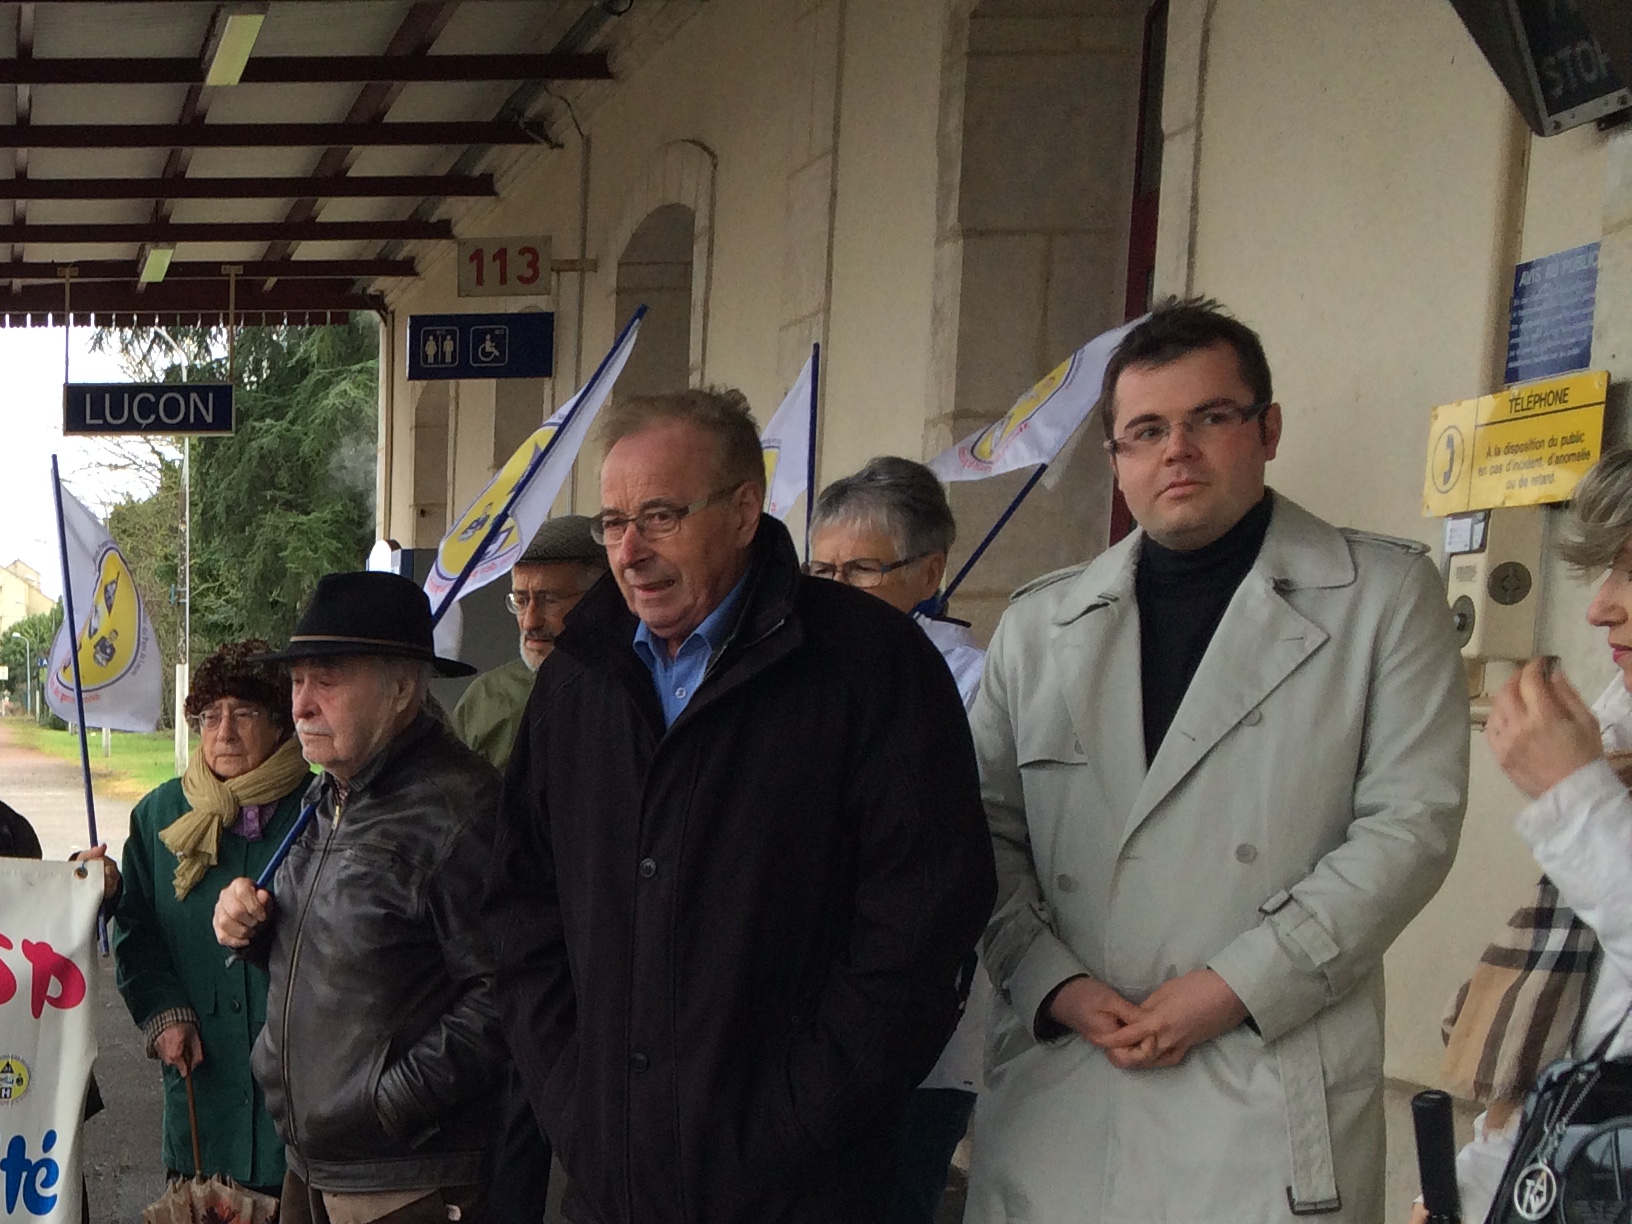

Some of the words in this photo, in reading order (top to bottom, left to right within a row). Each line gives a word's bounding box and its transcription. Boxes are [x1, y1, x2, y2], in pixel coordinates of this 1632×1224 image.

[469, 246, 540, 287] 113
[85, 392, 214, 430] LUÇON
[1548, 434, 1558, 448] du
[1560, 430, 1585, 449] public
